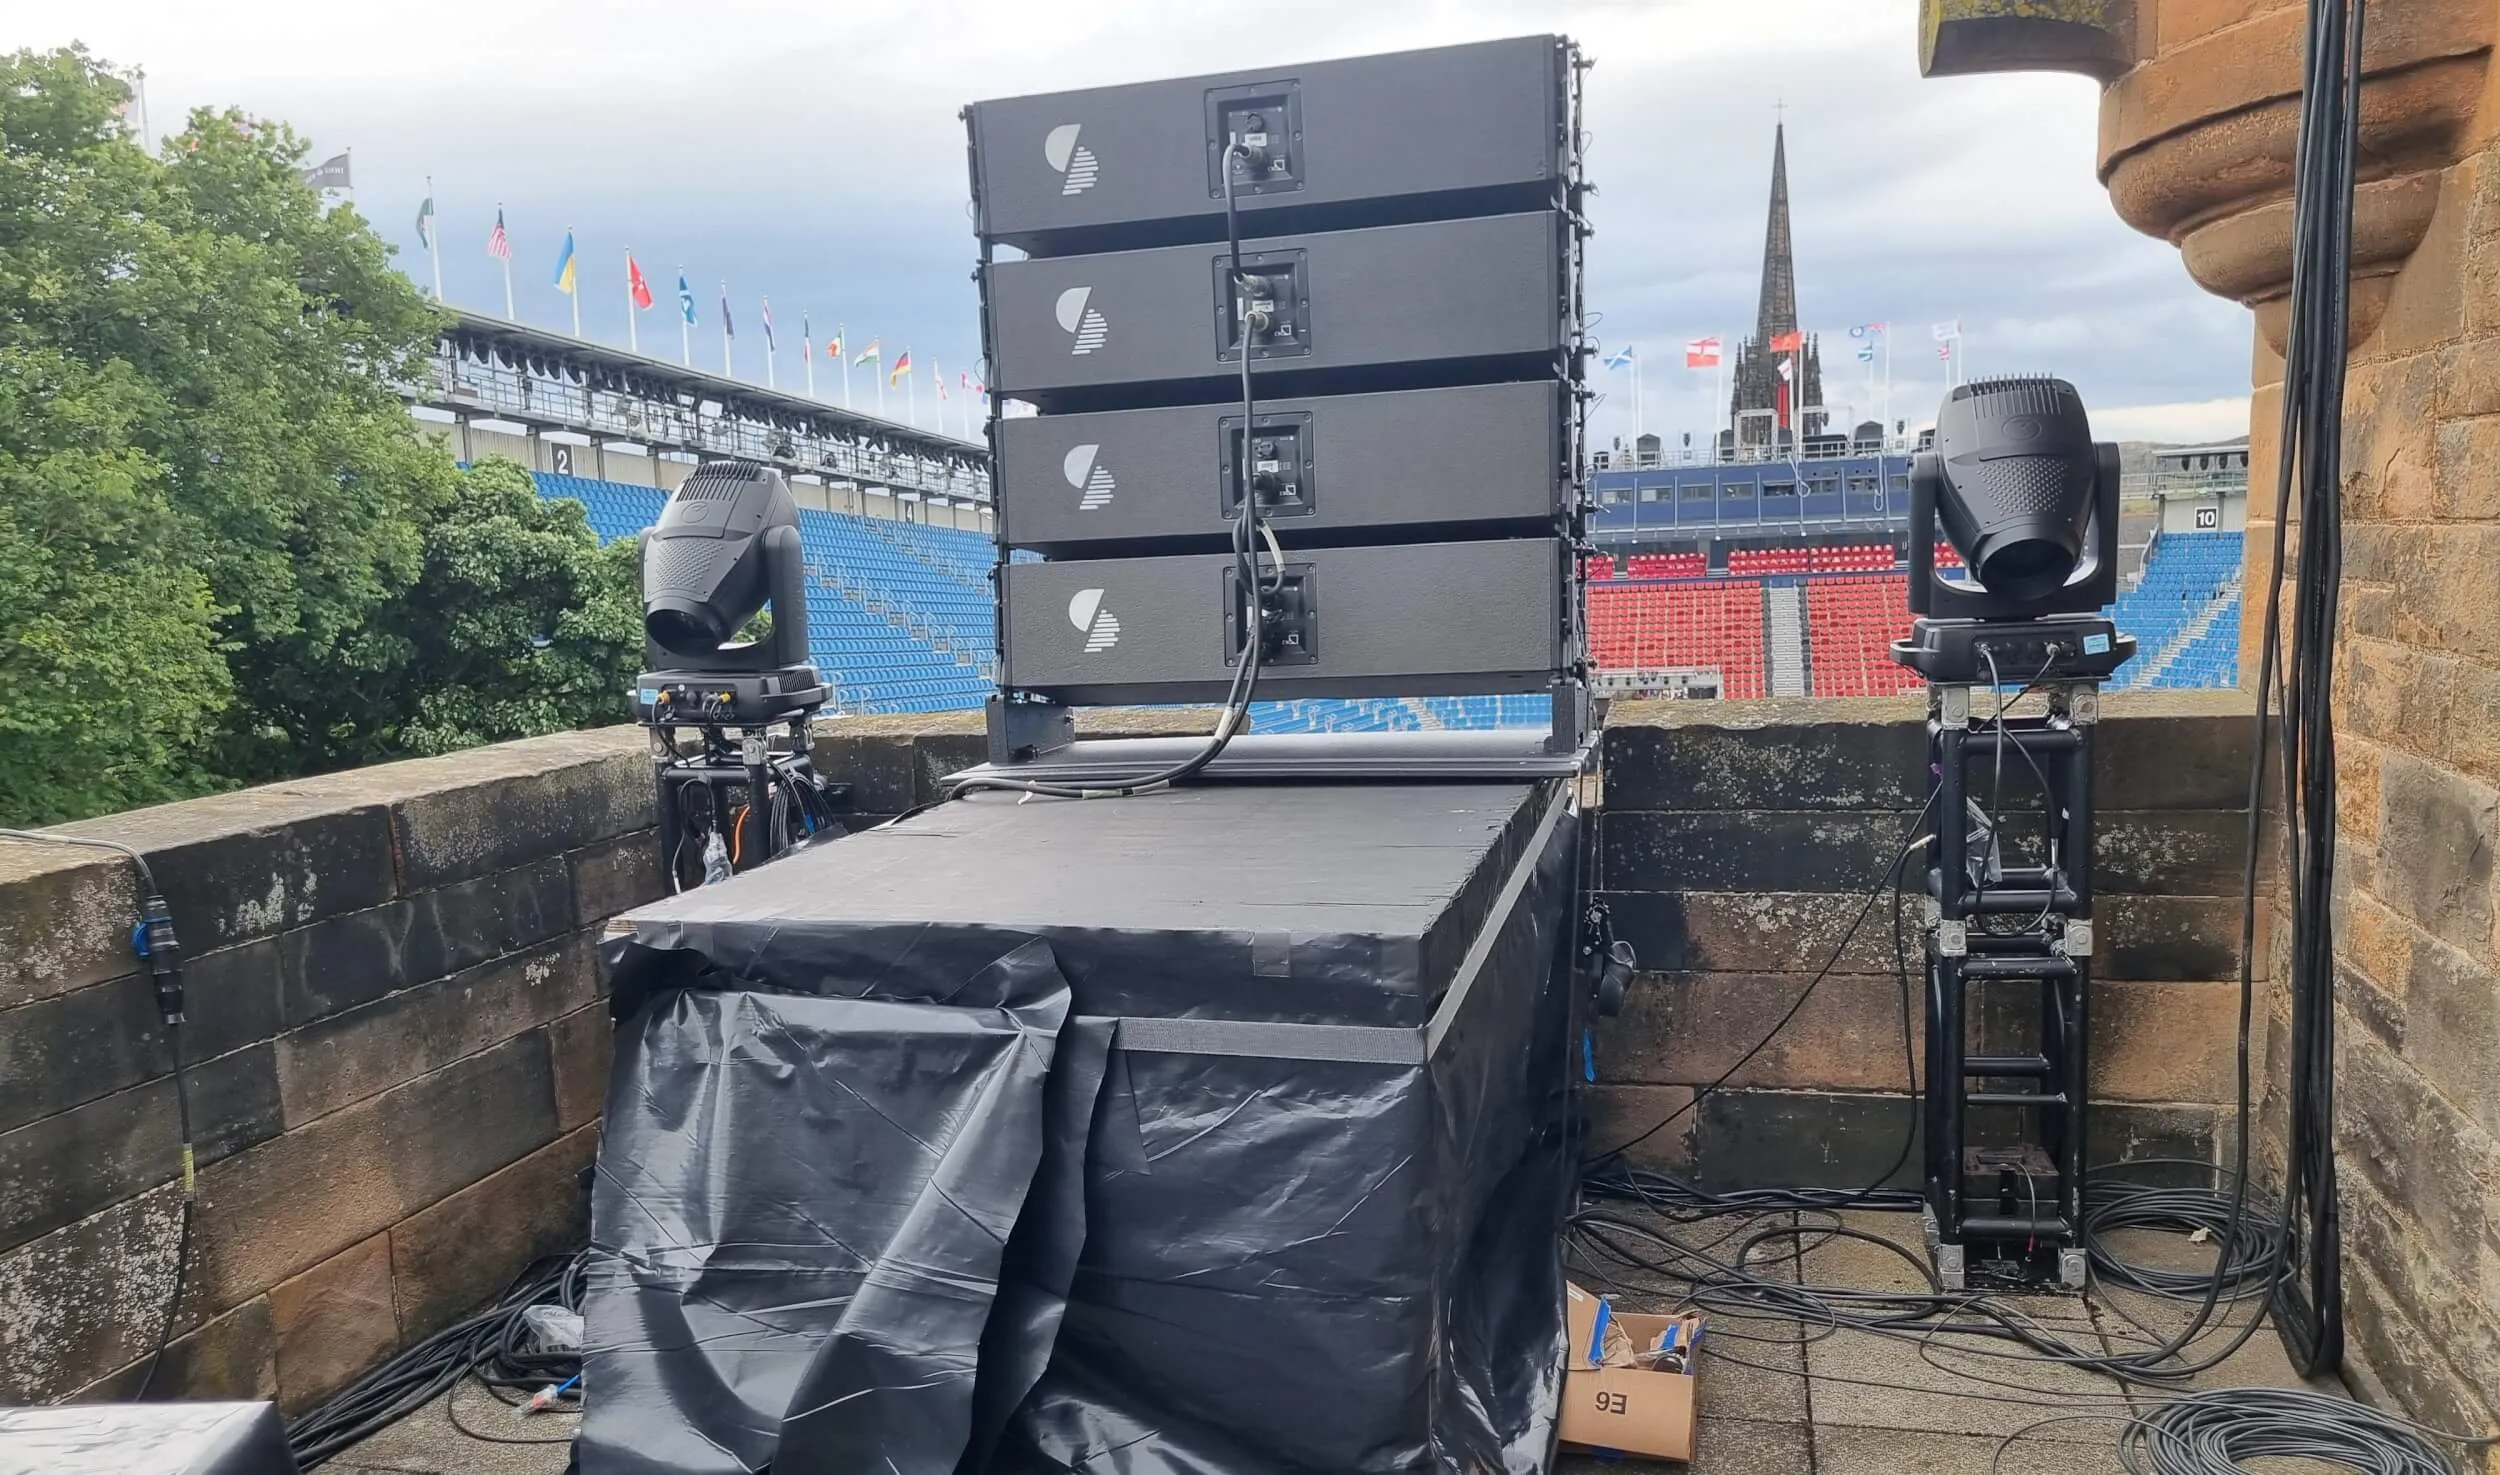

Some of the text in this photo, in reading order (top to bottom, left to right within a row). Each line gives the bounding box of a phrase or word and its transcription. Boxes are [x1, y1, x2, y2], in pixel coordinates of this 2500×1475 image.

[557, 449, 569, 475] 2
[2197, 511, 2216, 526] 10
[1595, 1391, 1628, 1415] E6
